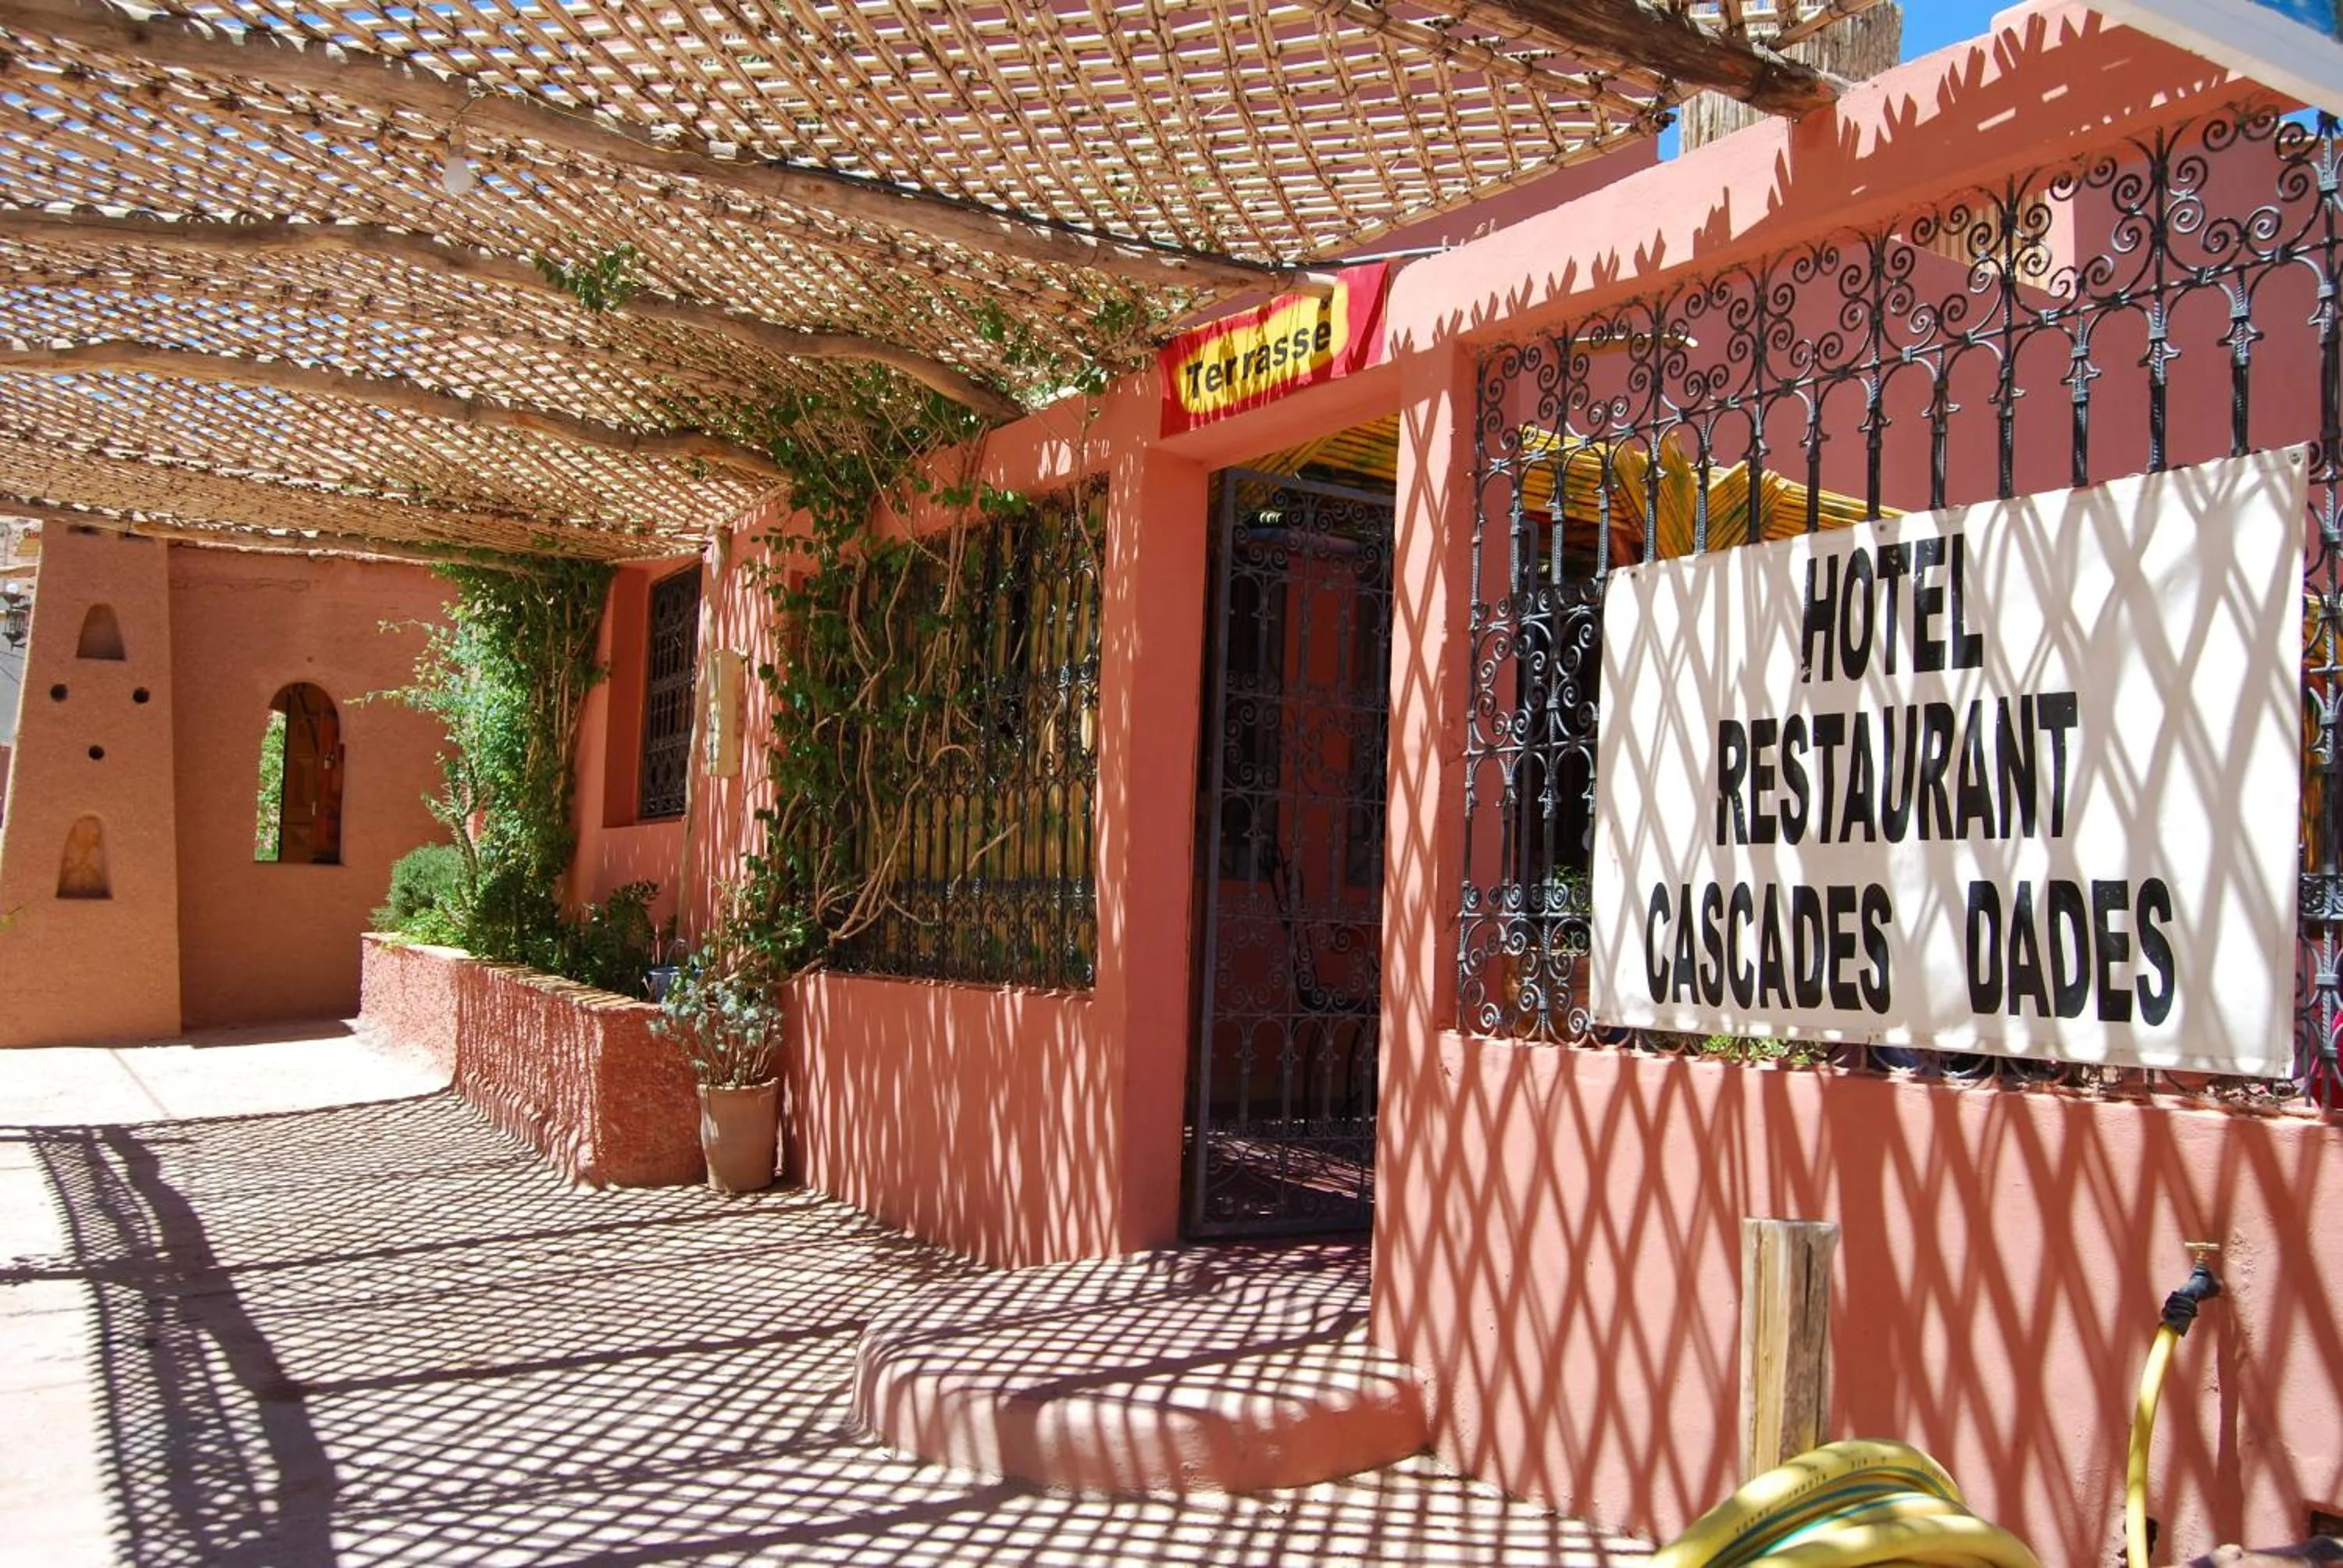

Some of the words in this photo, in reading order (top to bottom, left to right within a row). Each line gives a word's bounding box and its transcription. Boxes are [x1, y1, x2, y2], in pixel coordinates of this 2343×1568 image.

[1186, 319, 1332, 399] Terrasse
[1800, 533, 1984, 682] HOTEL
[1716, 691, 2079, 846] RESTAURANT
[1645, 882, 1893, 1014] CASCADES
[1966, 877, 2176, 1027] DADES
